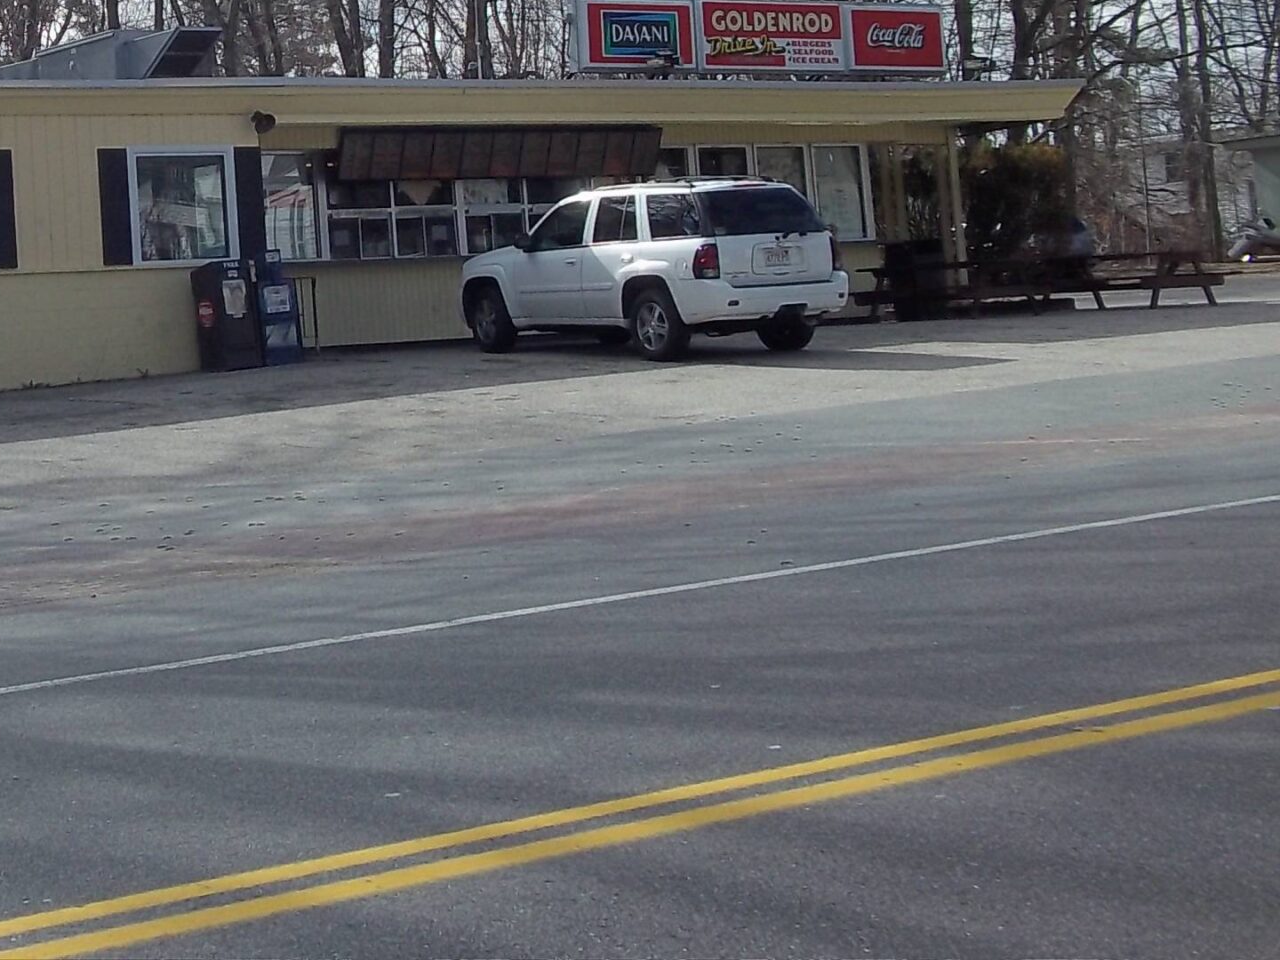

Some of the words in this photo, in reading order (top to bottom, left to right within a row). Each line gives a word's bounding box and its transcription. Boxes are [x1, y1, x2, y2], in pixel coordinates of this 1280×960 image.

[711, 10, 833, 33] GOLDENROD
[612, 23, 668, 44] DASANI
[792, 40, 833, 48] BURGERS
[867, 23, 925, 48] Coca-Cola
[707, 35, 755, 55] Drive
[747, 34, 786, 56] In
[792, 48, 835, 56] SEAFOOD
[792, 56, 805, 64] ICE
[808, 56, 840, 65] CREAM
